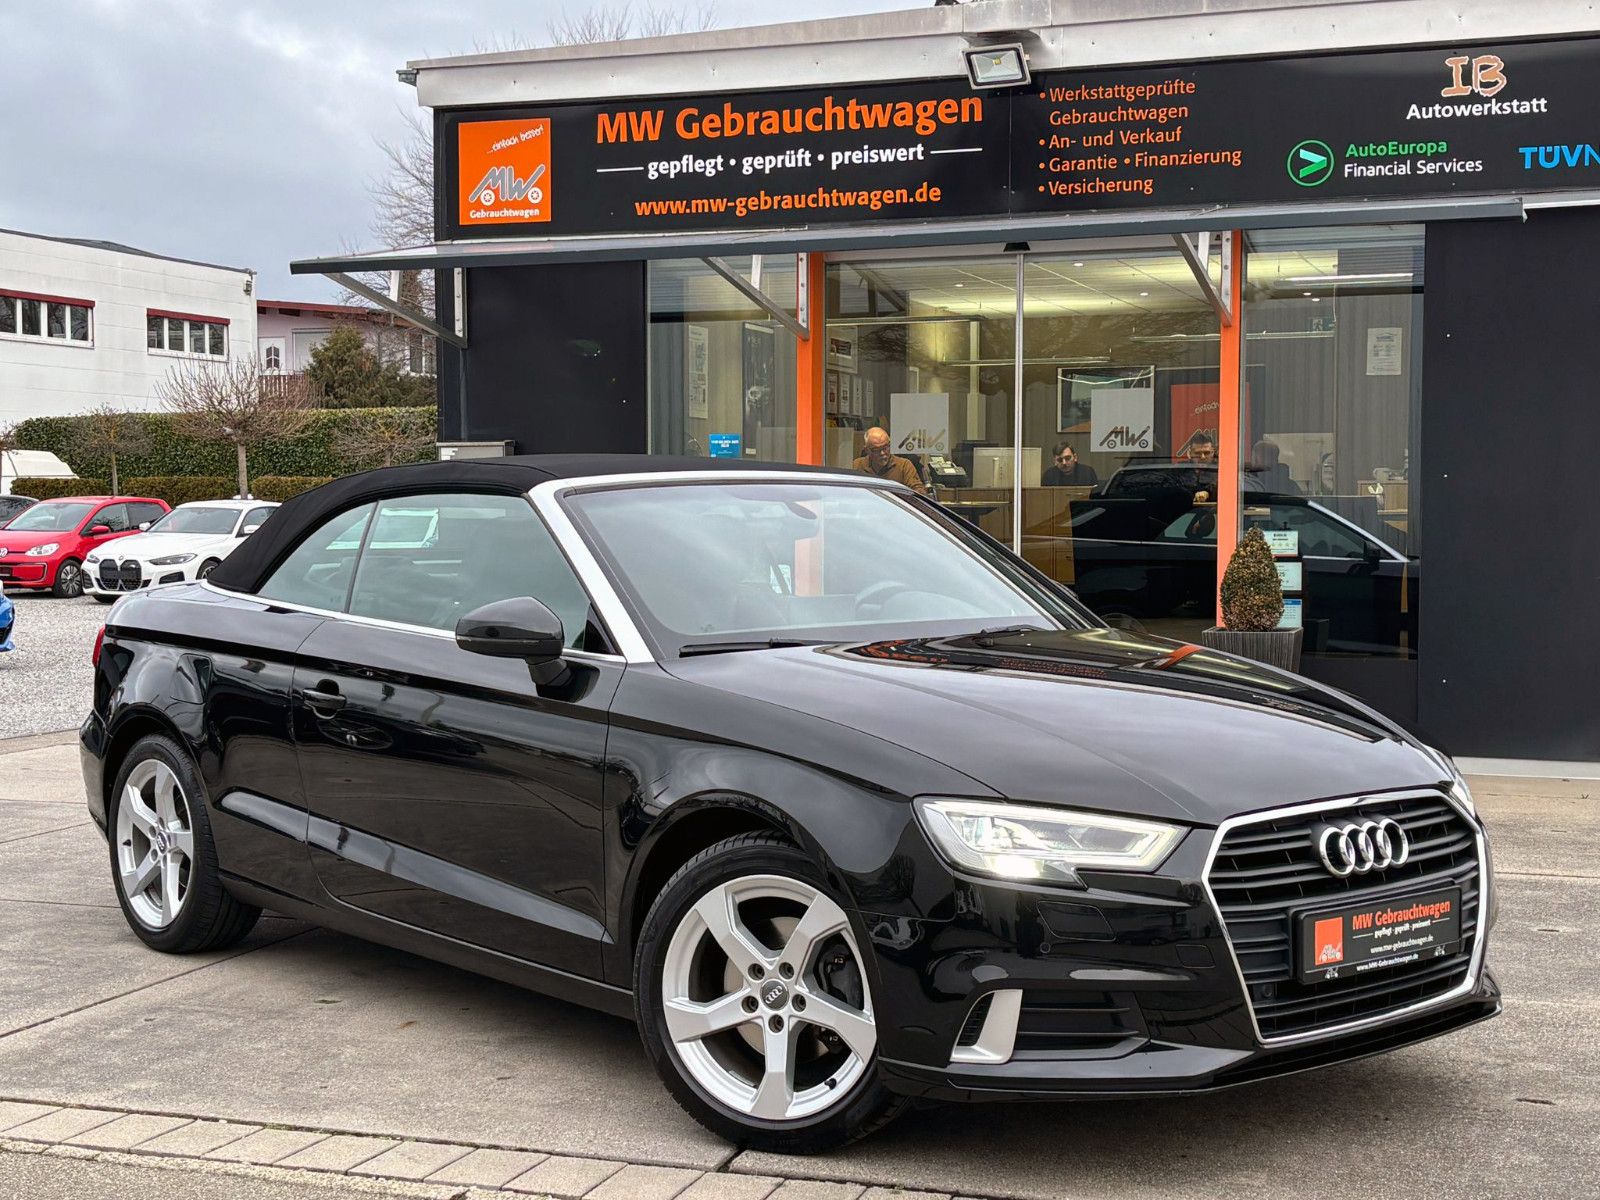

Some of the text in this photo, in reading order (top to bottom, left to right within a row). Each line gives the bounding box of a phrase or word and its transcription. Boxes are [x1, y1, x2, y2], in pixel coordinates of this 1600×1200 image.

[1049, 79, 1196, 103] Werkstattgeprüfte
[597, 95, 983, 144] MW Gebrauchtwagen
[1049, 105, 1189, 126] Gebrauchtwagen
[1406, 97, 1548, 120] Autowerkstatt
[1049, 126, 1182, 149] An- und Verkauf
[1346, 140, 1447, 157] AutoEuropa
[647, 144, 925, 180] gepflegt geprüft preiswert
[1049, 149, 1242, 173] Garantie Finanzierung
[1344, 157, 1483, 178] Financial Services
[1049, 178, 1153, 196] Versicherung
[634, 182, 942, 217] www.mw-gebrauchtwagen.de
[470, 208, 540, 219] Gebrauchtwagen
[1352, 901, 1451, 930] MW Gebrauchtwagen
